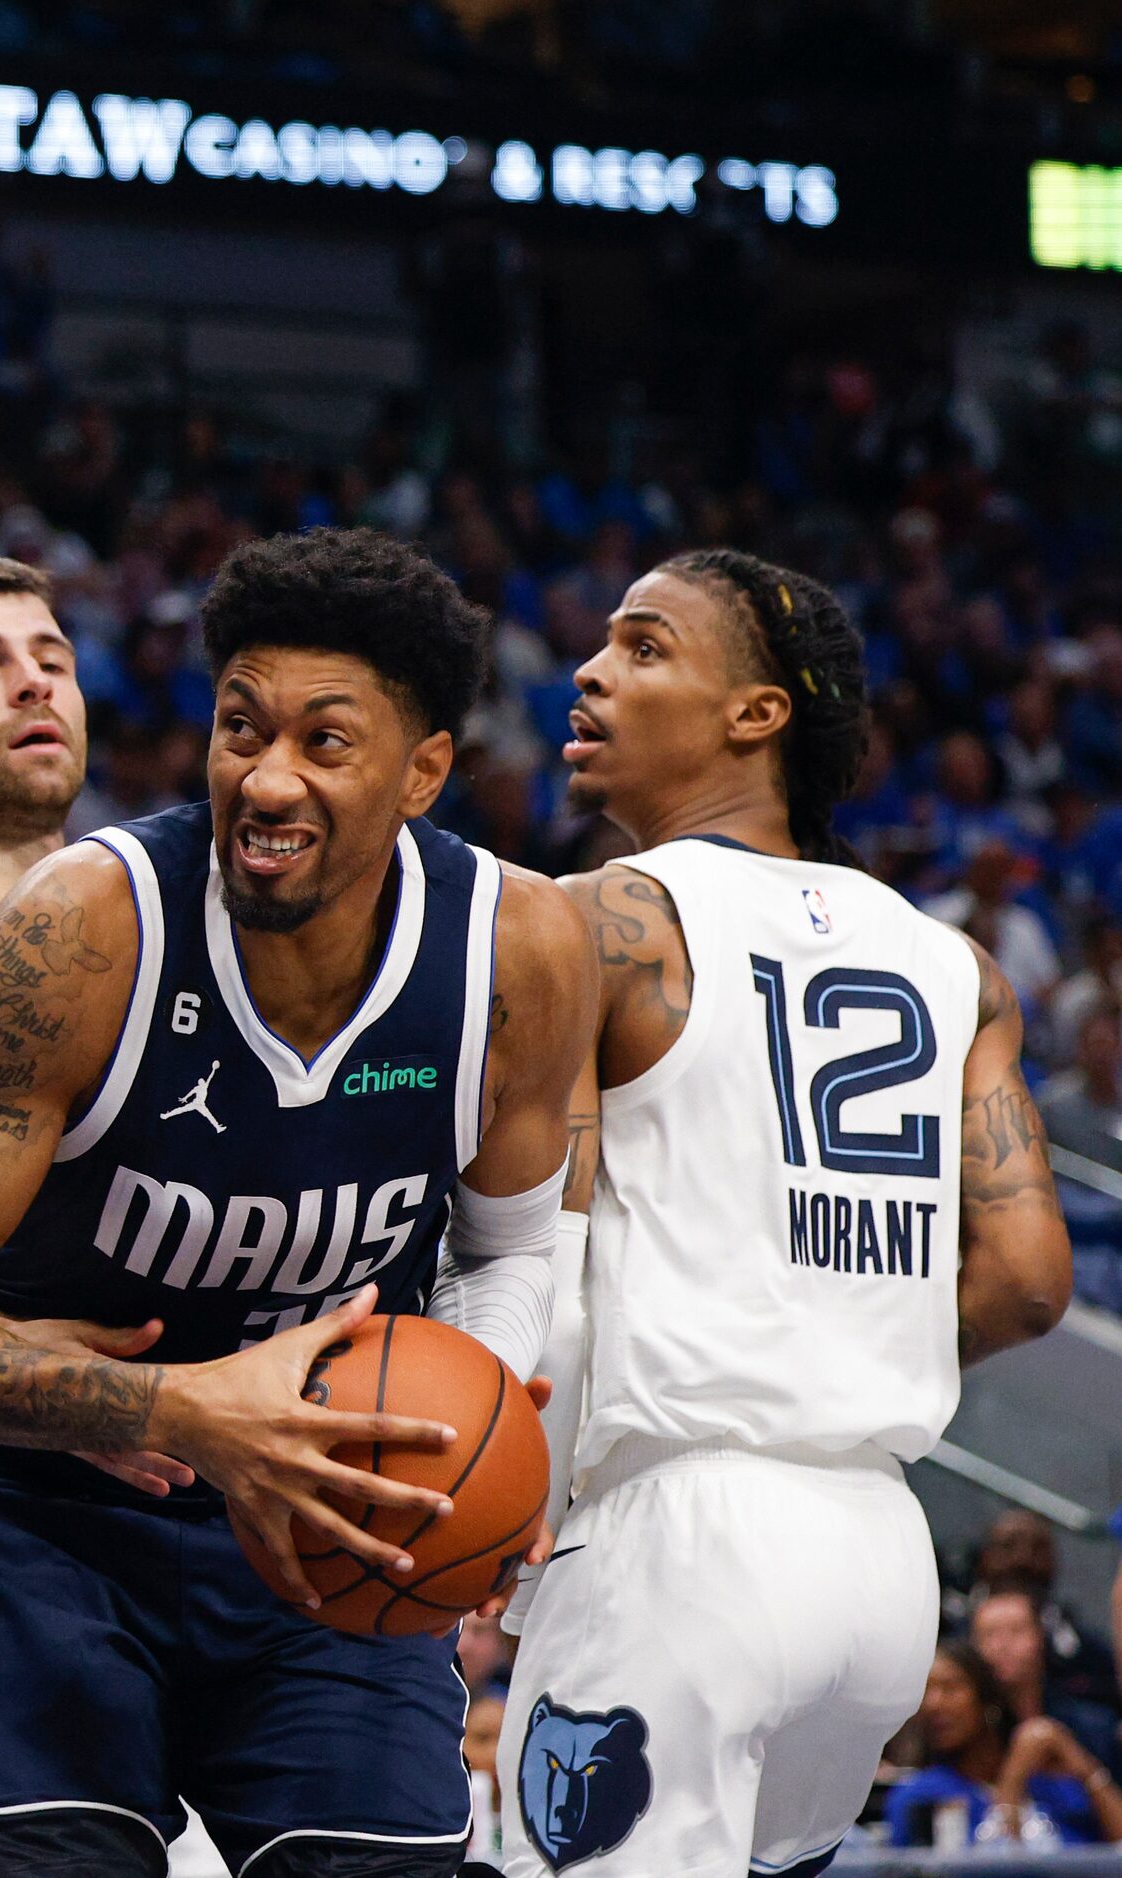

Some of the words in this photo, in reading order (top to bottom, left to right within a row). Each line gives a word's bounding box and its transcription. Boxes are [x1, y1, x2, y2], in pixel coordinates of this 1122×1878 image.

[184, 113, 448, 197] CASINO
[491, 139, 544, 203] &
[171, 991, 201, 1035] 6
[342, 1062, 438, 1096] chime
[749, 951, 940, 1179] 12
[788, 1187, 938, 1279] MORANT
